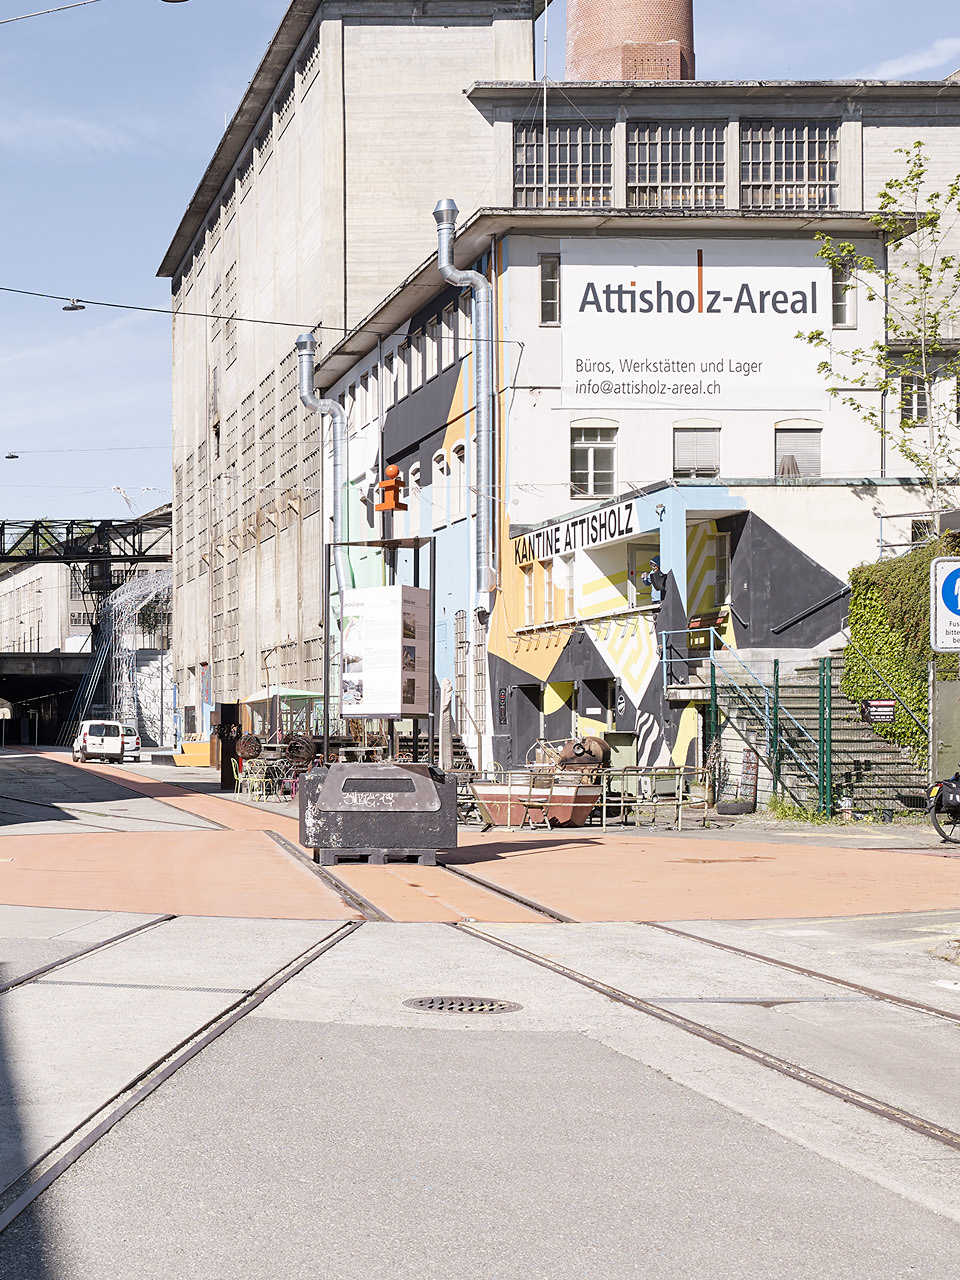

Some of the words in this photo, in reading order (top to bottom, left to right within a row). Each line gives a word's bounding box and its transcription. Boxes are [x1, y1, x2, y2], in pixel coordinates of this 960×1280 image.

[578, 249, 817, 314] Attisholz-Areal
[575, 358, 615, 374] Büros,
[619, 358, 696, 373] Werkstätten
[700, 358, 724, 373] und
[728, 359, 762, 377] Lager
[575, 380, 721, 395] info@attisholz-areal.ch
[514, 526, 560, 565] KANTINE
[564, 502, 633, 552] ATTISHOLZ
